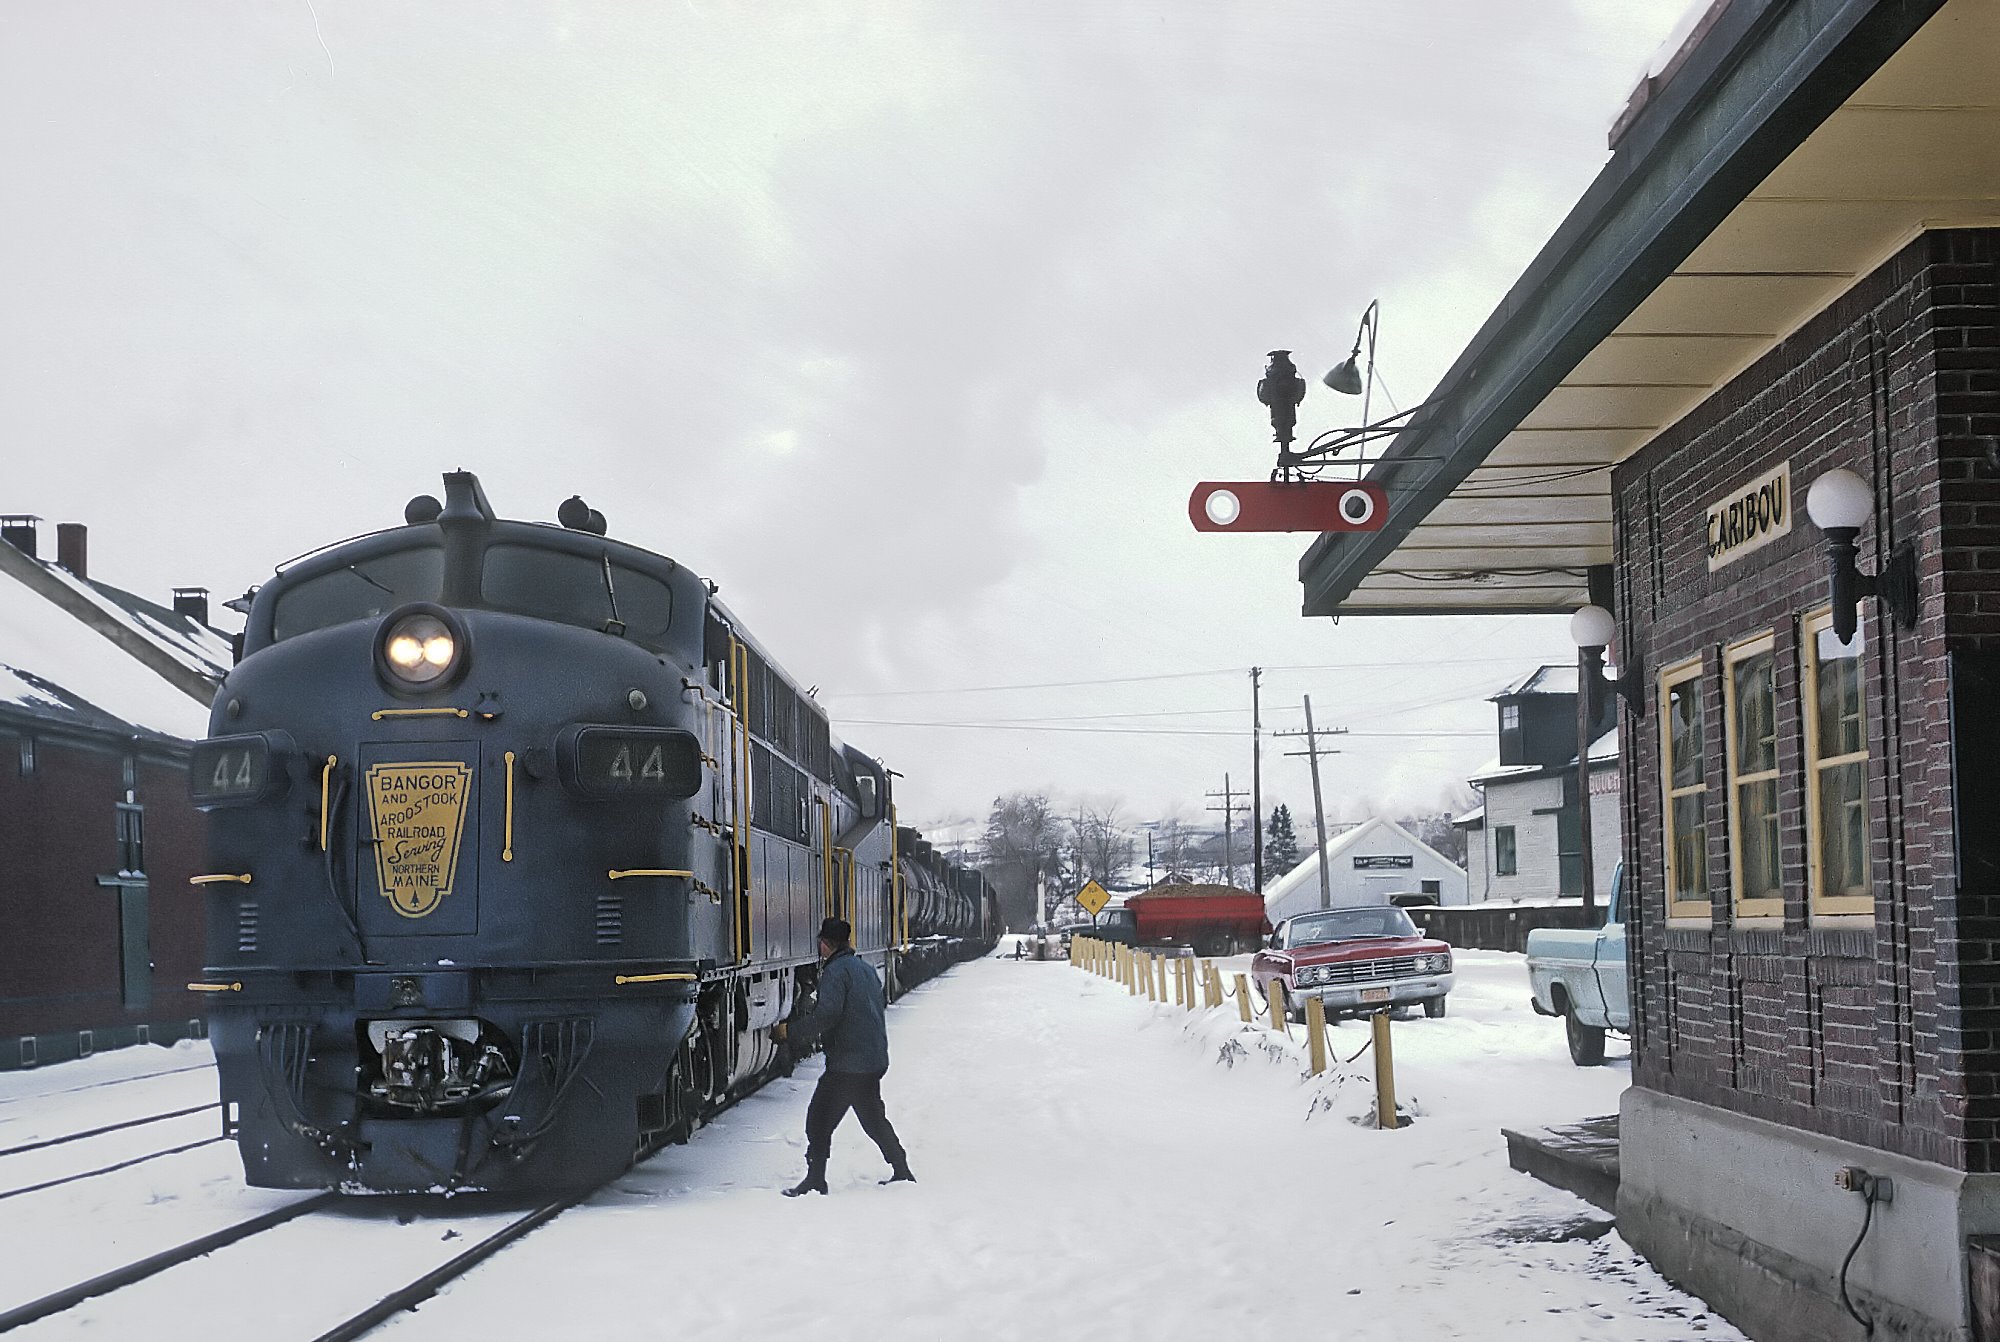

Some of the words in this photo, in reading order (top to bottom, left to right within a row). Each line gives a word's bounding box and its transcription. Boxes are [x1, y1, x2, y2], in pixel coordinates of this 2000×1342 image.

[1707, 476, 1783, 558] CARIBOU
[212, 750, 251, 790] 44
[610, 743, 665, 782] 44
[381, 774, 457, 791] BANGOR
[380, 792, 458, 827] AROOSTOOK
[381, 793, 408, 805] AND
[387, 826, 446, 840] RAILROAD
[387, 837, 447, 864] Serving
[392, 864, 440, 874] NORTHERN
[393, 874, 440, 888] MAINE
